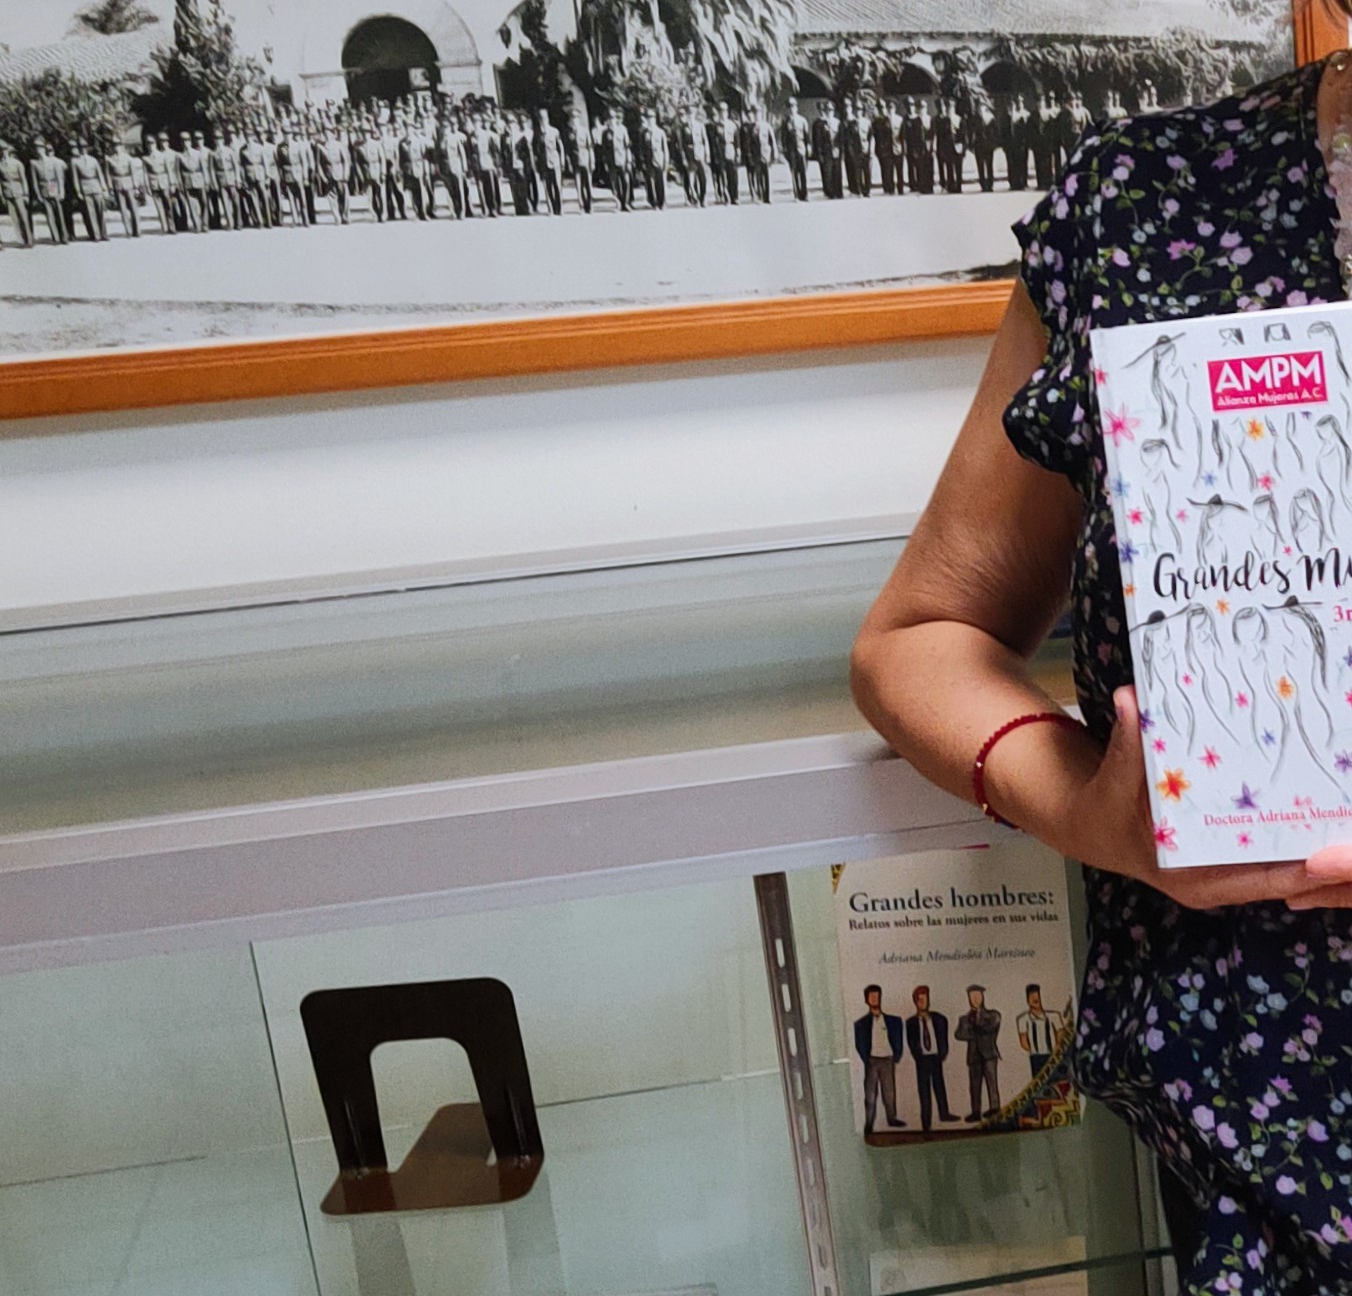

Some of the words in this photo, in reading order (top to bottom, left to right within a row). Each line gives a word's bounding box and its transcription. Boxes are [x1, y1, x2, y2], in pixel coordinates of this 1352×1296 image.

[1214, 353, 1323, 394] AMPM
[1217, 395, 1257, 406] Alianza
[1152, 550, 1291, 601] Grandes
[1203, 813, 1253, 826] Doctora
[1256, 810, 1306, 823] Adriana
[849, 888, 944, 913] Grandes
[950, 884, 1055, 908] hombres:
[849, 917, 891, 931] Relatos
[893, 915, 924, 928] sobre
[926, 915, 943, 927] las
[945, 914, 990, 927] mujeres
[992, 915, 1006, 924] en
[1030, 910, 1060, 922] vidas
